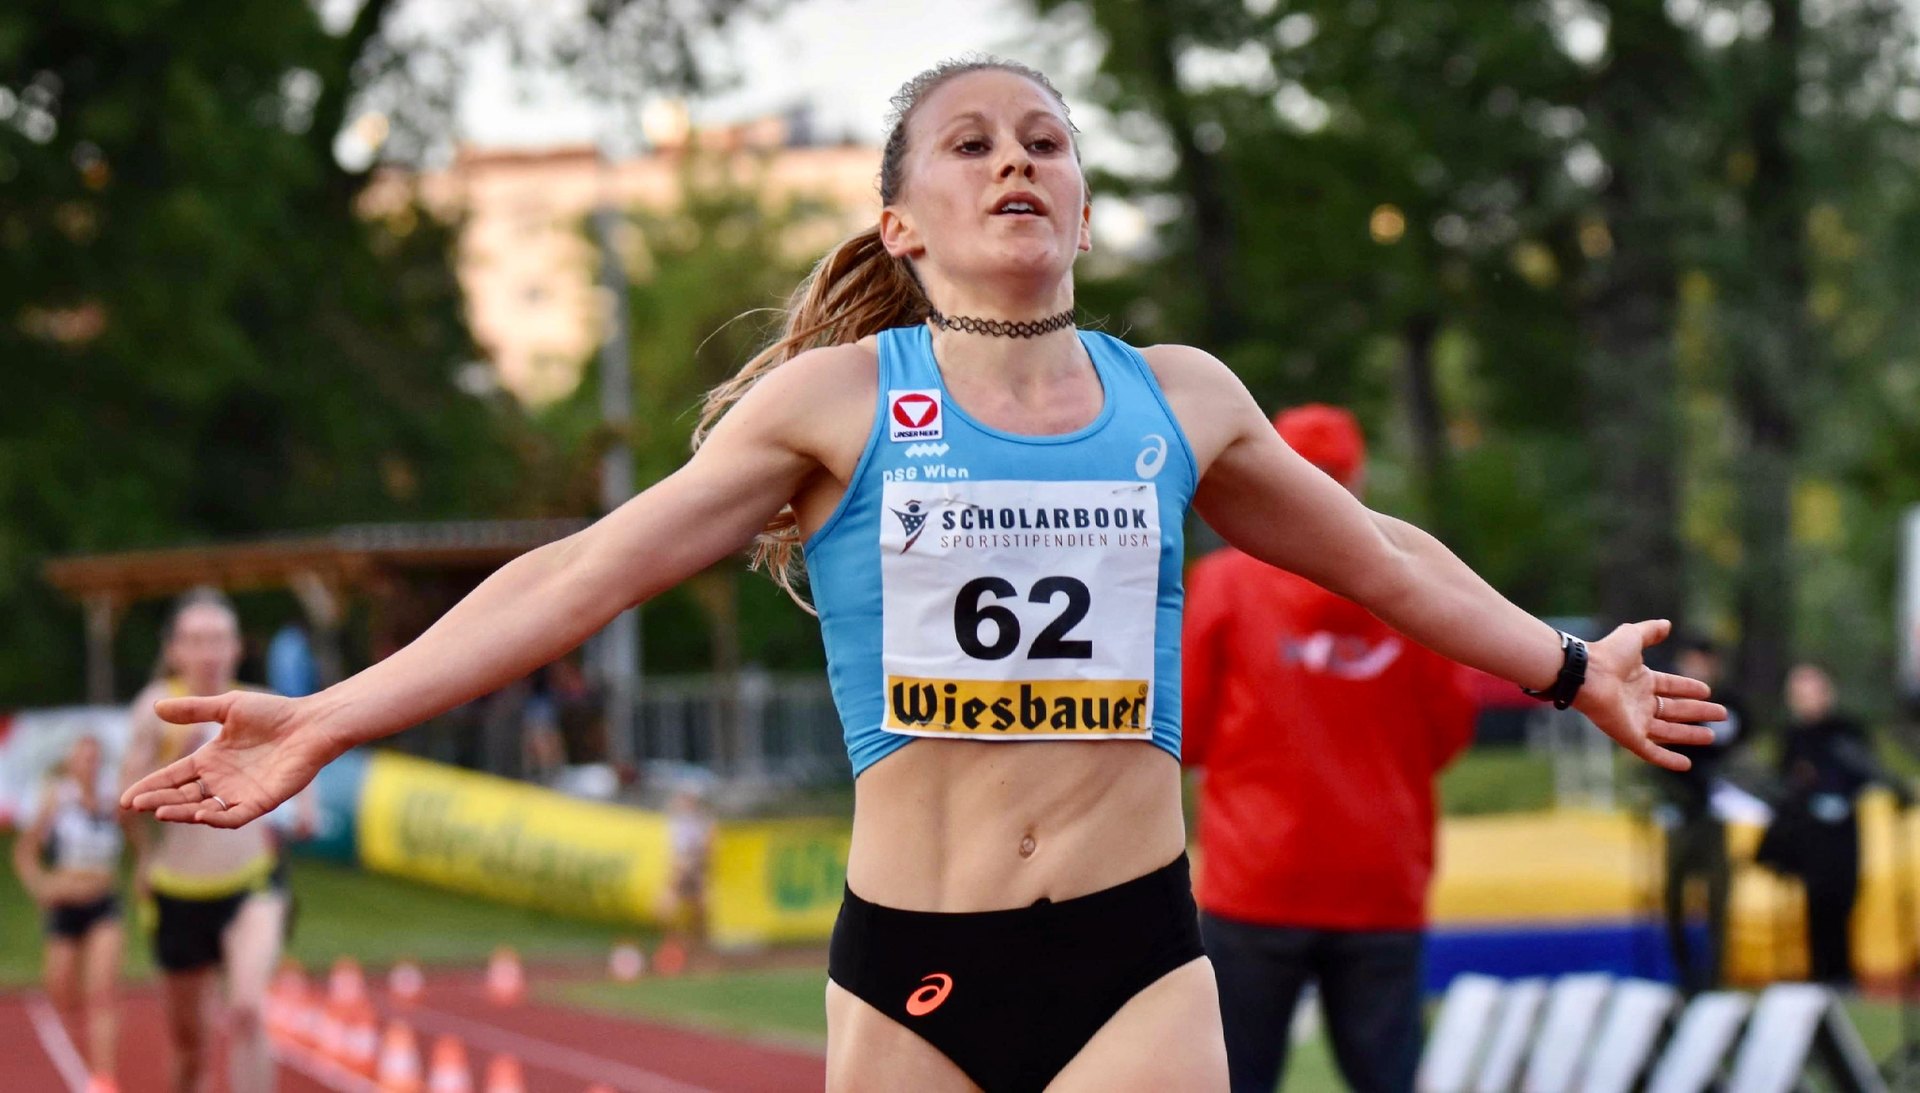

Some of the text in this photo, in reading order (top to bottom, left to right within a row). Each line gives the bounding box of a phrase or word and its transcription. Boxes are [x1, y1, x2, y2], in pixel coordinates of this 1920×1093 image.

[923, 463, 969, 478] Wien
[941, 507, 1148, 531] SCHOLARBOOK
[940, 534, 1149, 549] SPORTSTIPENDIEN USA
[954, 576, 1093, 661] 62
[892, 682, 1147, 731] Wiesbauer
